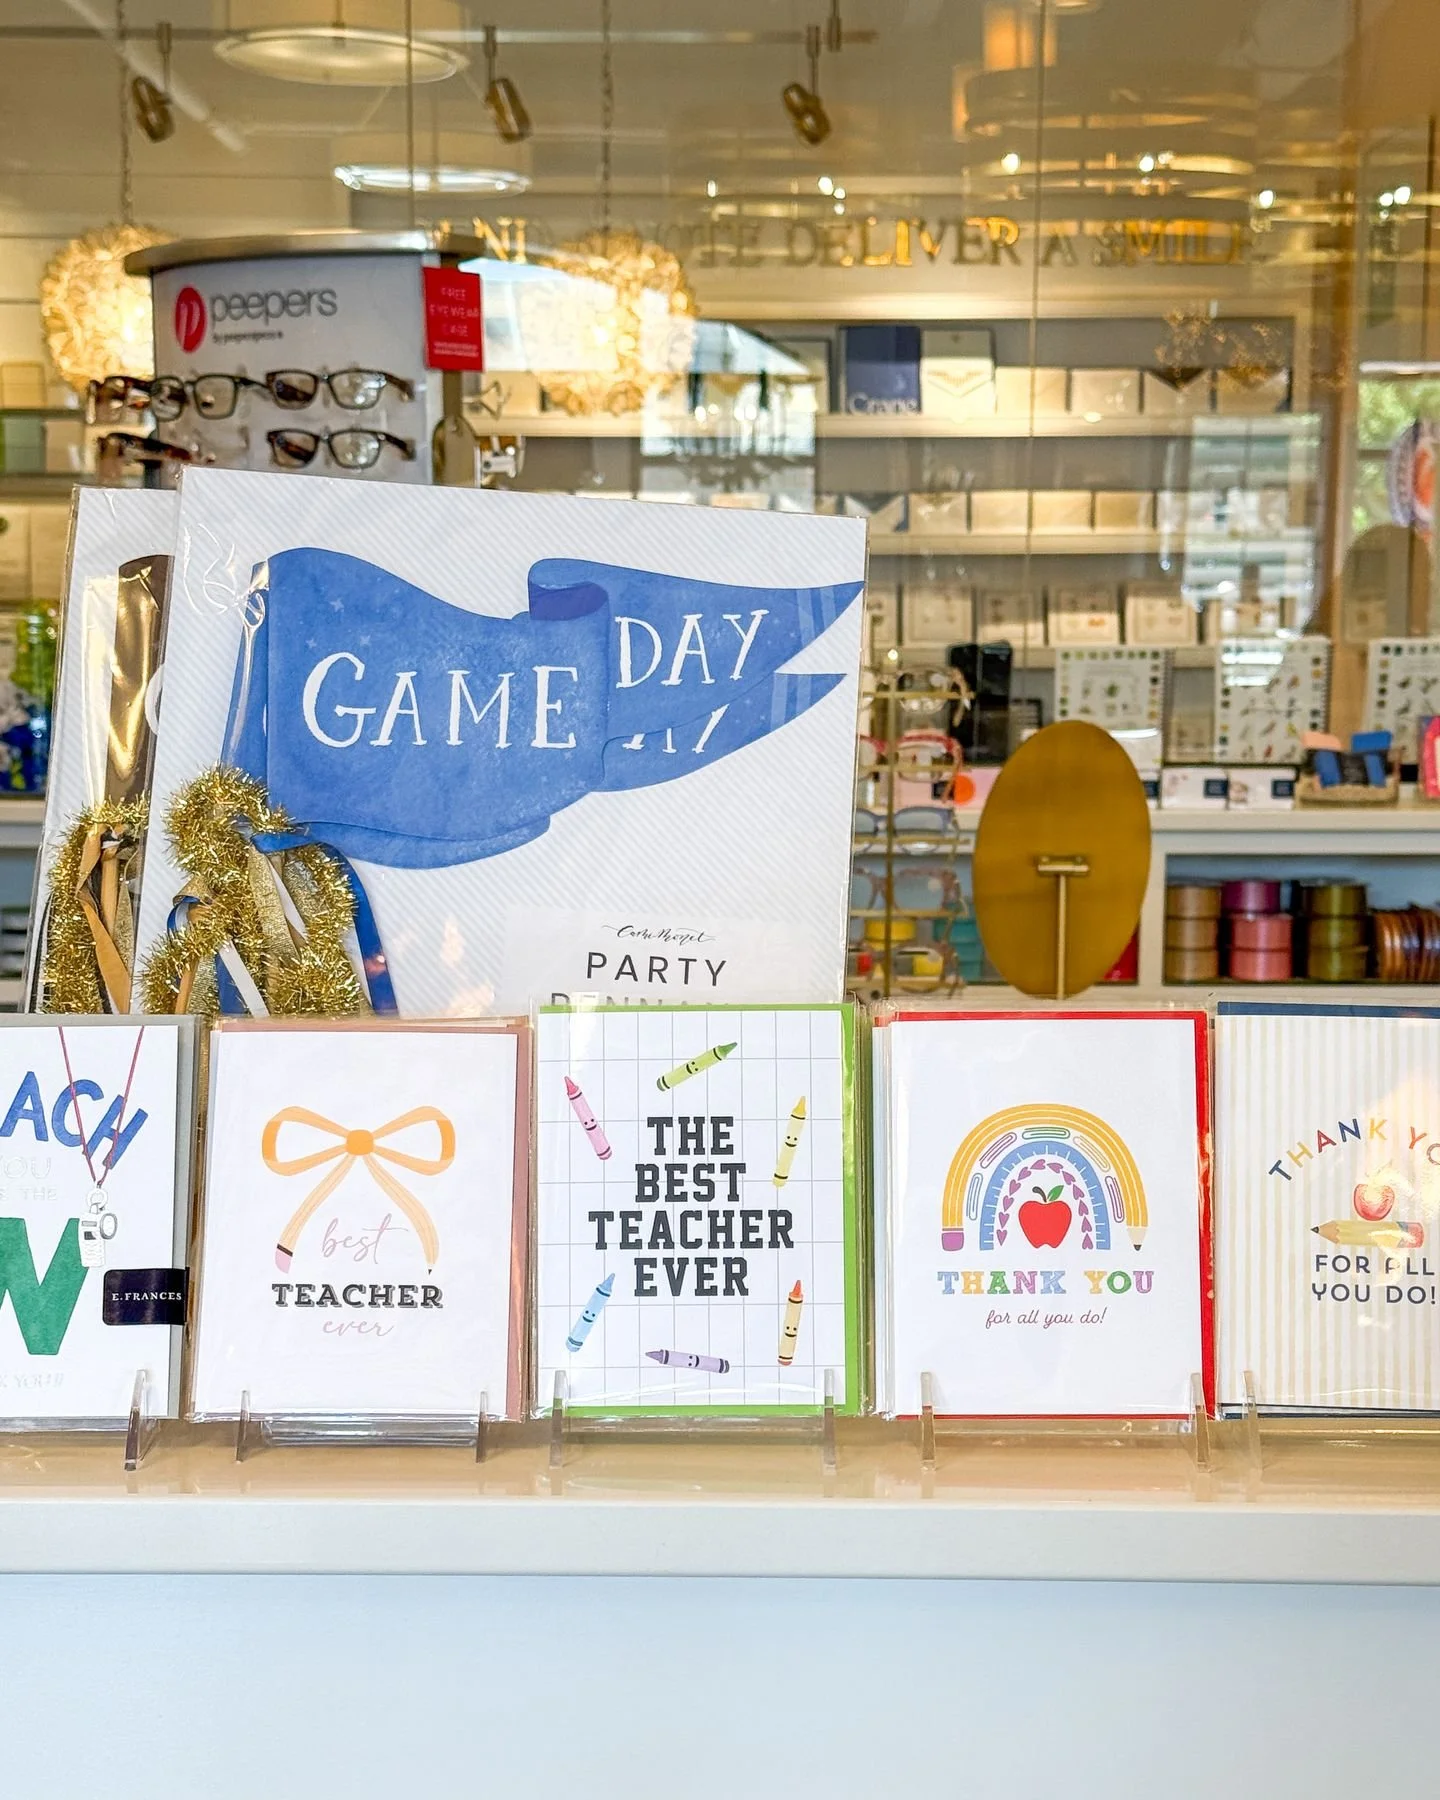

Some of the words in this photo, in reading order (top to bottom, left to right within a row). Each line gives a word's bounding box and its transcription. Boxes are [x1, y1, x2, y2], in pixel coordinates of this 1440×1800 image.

[783, 215, 1020, 268] DELIVER
[210, 287, 338, 332] peepers
[303, 651, 578, 748] GAME
[615, 609, 770, 688] DAY
[586, 951, 727, 987] PARTY
[647, 1116, 734, 1155] THE
[1268, 1118, 1388, 1181] THANK
[635, 1163, 746, 1202] BEST
[322, 1213, 409, 1264] best
[588, 1210, 794, 1250] TEACHER
[634, 1257, 748, 1297] EVER
[937, 1271, 1066, 1295] THANK
[1084, 1270, 1155, 1294] YOU
[1315, 1254, 1370, 1274] FOR
[272, 1284, 443, 1308] TEACHER
[1312, 1283, 1370, 1302] YOU
[1386, 1285, 1436, 1305] DO!
[322, 1319, 393, 1336] ever
[985, 1309, 1011, 1329] for
[1017, 1310, 1039, 1324] all
[1043, 1313, 1073, 1329] you
[1080, 1307, 1108, 1324] do!
